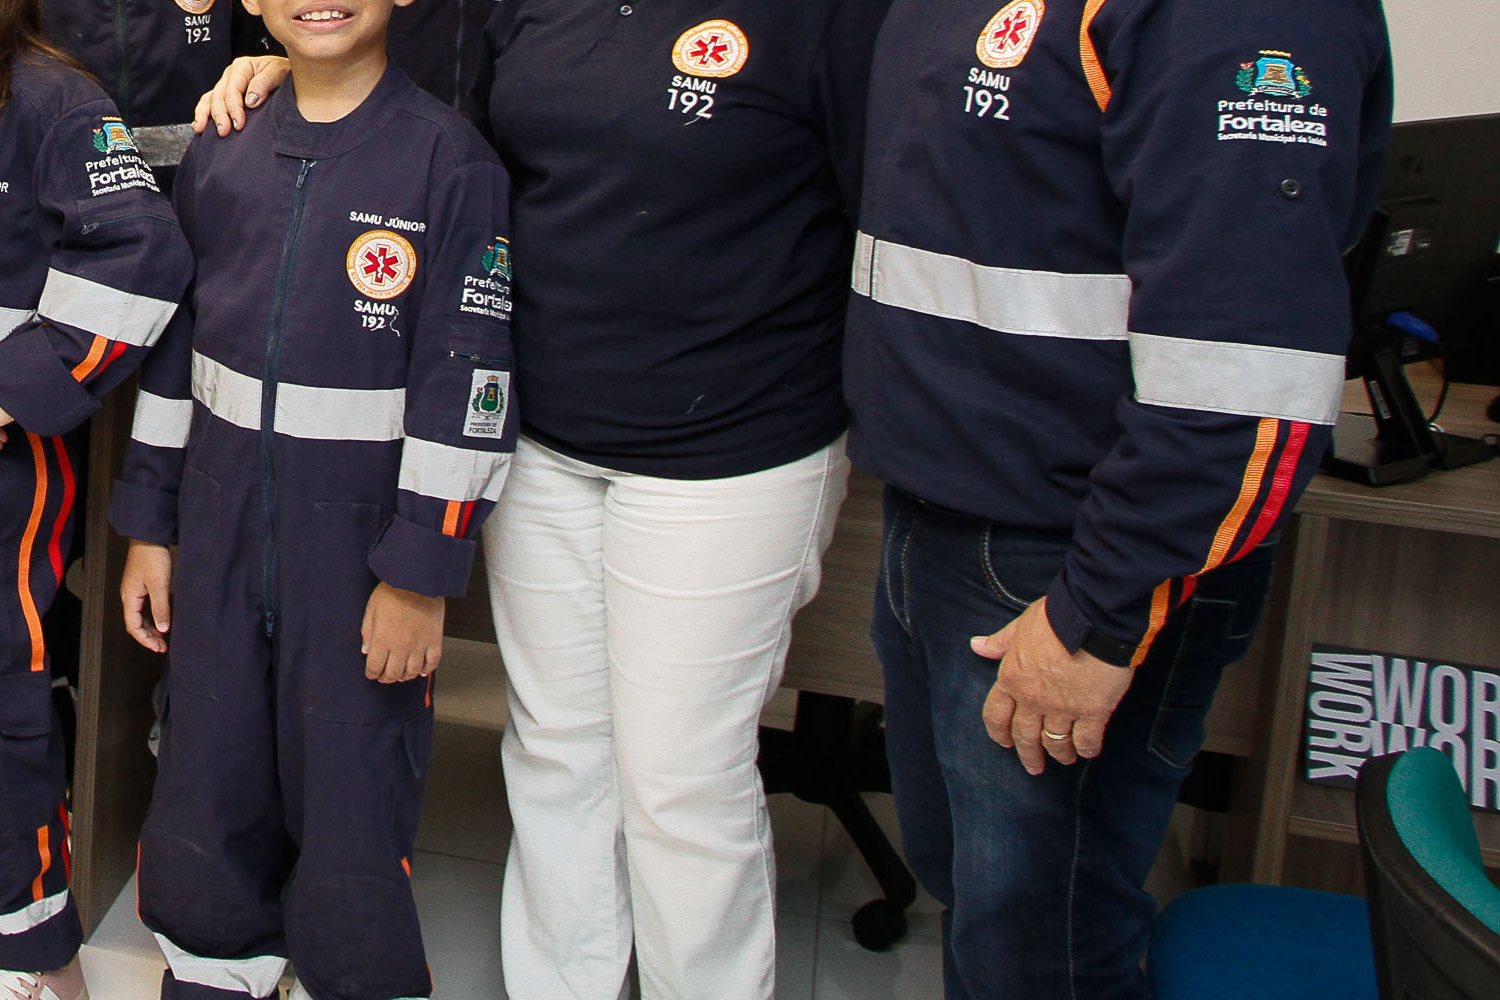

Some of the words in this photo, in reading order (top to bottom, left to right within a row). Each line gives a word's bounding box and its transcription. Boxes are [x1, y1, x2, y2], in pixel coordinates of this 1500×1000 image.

[184, 14, 211, 26] SAMU
[185, 27, 211, 44] 192
[671, 75, 717, 95] SAMU
[968, 67, 1011, 91] SAMU
[667, 88, 714, 119] 192
[963, 86, 1010, 121] 192
[1218, 99, 1305, 114] Prefeitura
[1308, 104, 1328, 117] de
[1218, 114, 1327, 137] Fortaleza
[349, 211, 382, 225] SAMU
[384, 216, 427, 232] JÚNIOR
[354, 299, 395, 315] SAMU
[362, 314, 386, 328] 192
[1371, 654, 1500, 741] WOR
[1308, 652, 1374, 779] WORK
